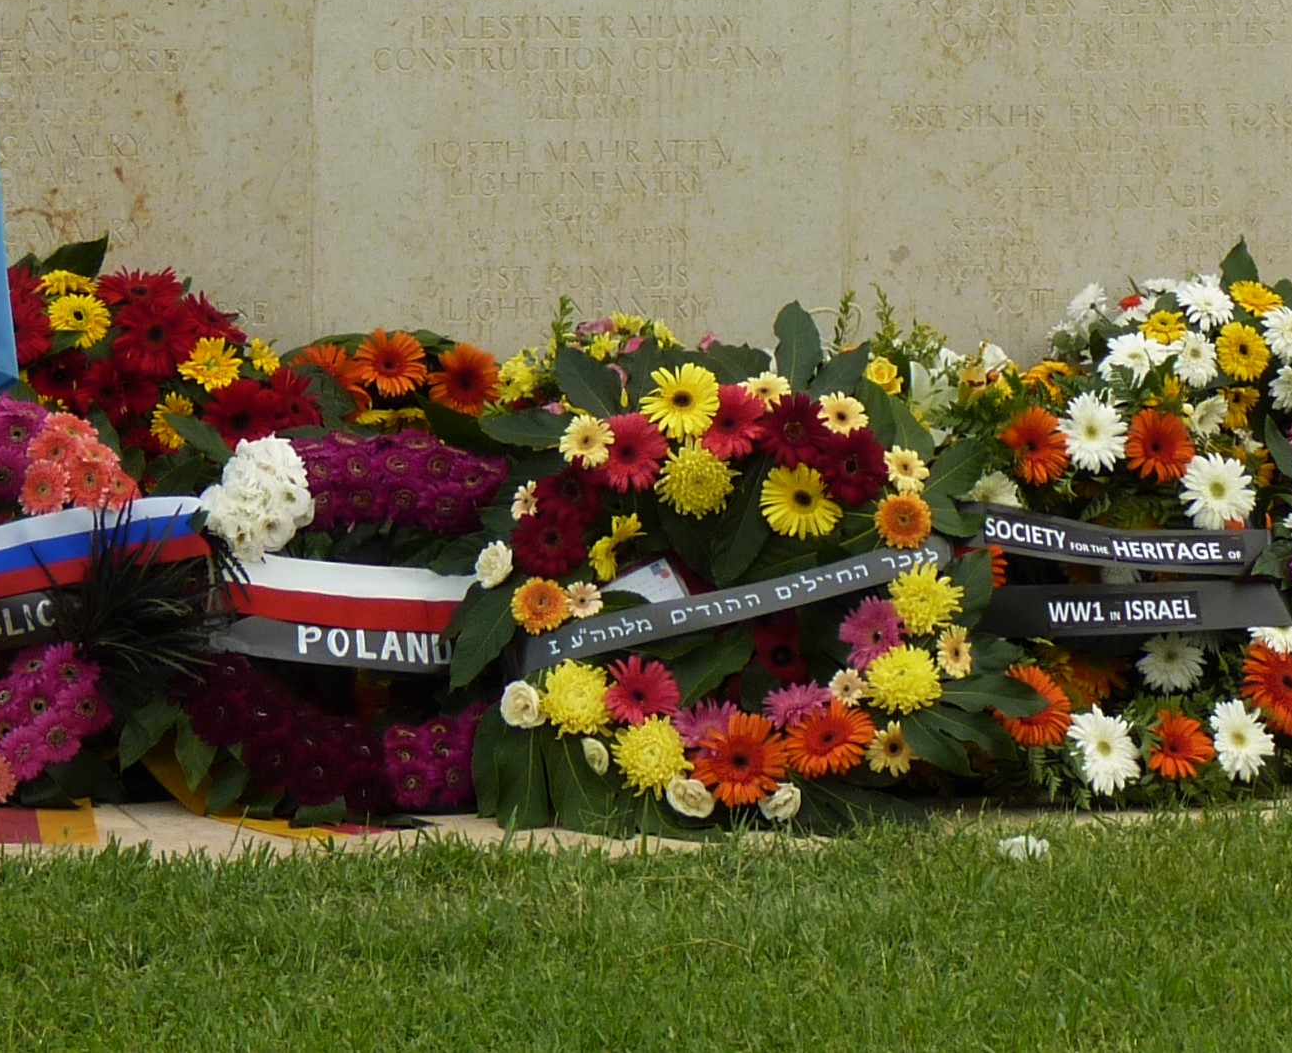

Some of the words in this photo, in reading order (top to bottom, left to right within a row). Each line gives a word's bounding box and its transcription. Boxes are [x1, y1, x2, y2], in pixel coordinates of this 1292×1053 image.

[0, 16, 147, 44] LANCERS
[420, 15, 584, 41] PALESTINE
[601, 16, 742, 41] RAILWAY
[938, 21, 1016, 49] OWN
[1034, 21, 1166, 49] GURKHA
[1185, 21, 1276, 48] RIFLES
[373, 47, 616, 74] CONSTRUCTION
[633, 47, 788, 74] COMPANY
[962, 102, 1048, 128] SIKHS
[1071, 102, 1209, 128] FRONTIER
[0, 134, 149, 160] CAVALRY
[432, 139, 526, 165] 105TH
[545, 139, 728, 166] MAHRATTA
[450, 170, 544, 197] LIGHT
[558, 170, 708, 197] INFANTRY
[1086, 185, 1223, 211] PUNJABIS
[545, 265, 690, 291] PUNJABIS
[985, 516, 1066, 550] SOCIETY
[1070, 541, 1090, 553] FOR
[1091, 544, 1110, 556] THE
[1112, 539, 1222, 562] HERITAGE
[1227, 550, 1241, 561] OF
[775, 560, 870, 601] החיילים
[670, 590, 762, 625] ההודים
[1048, 601, 1105, 624] WW1
[1110, 610, 1121, 621] IN
[1126, 598, 1197, 622] ISRAEL
[297, 624, 452, 665] POLAND
